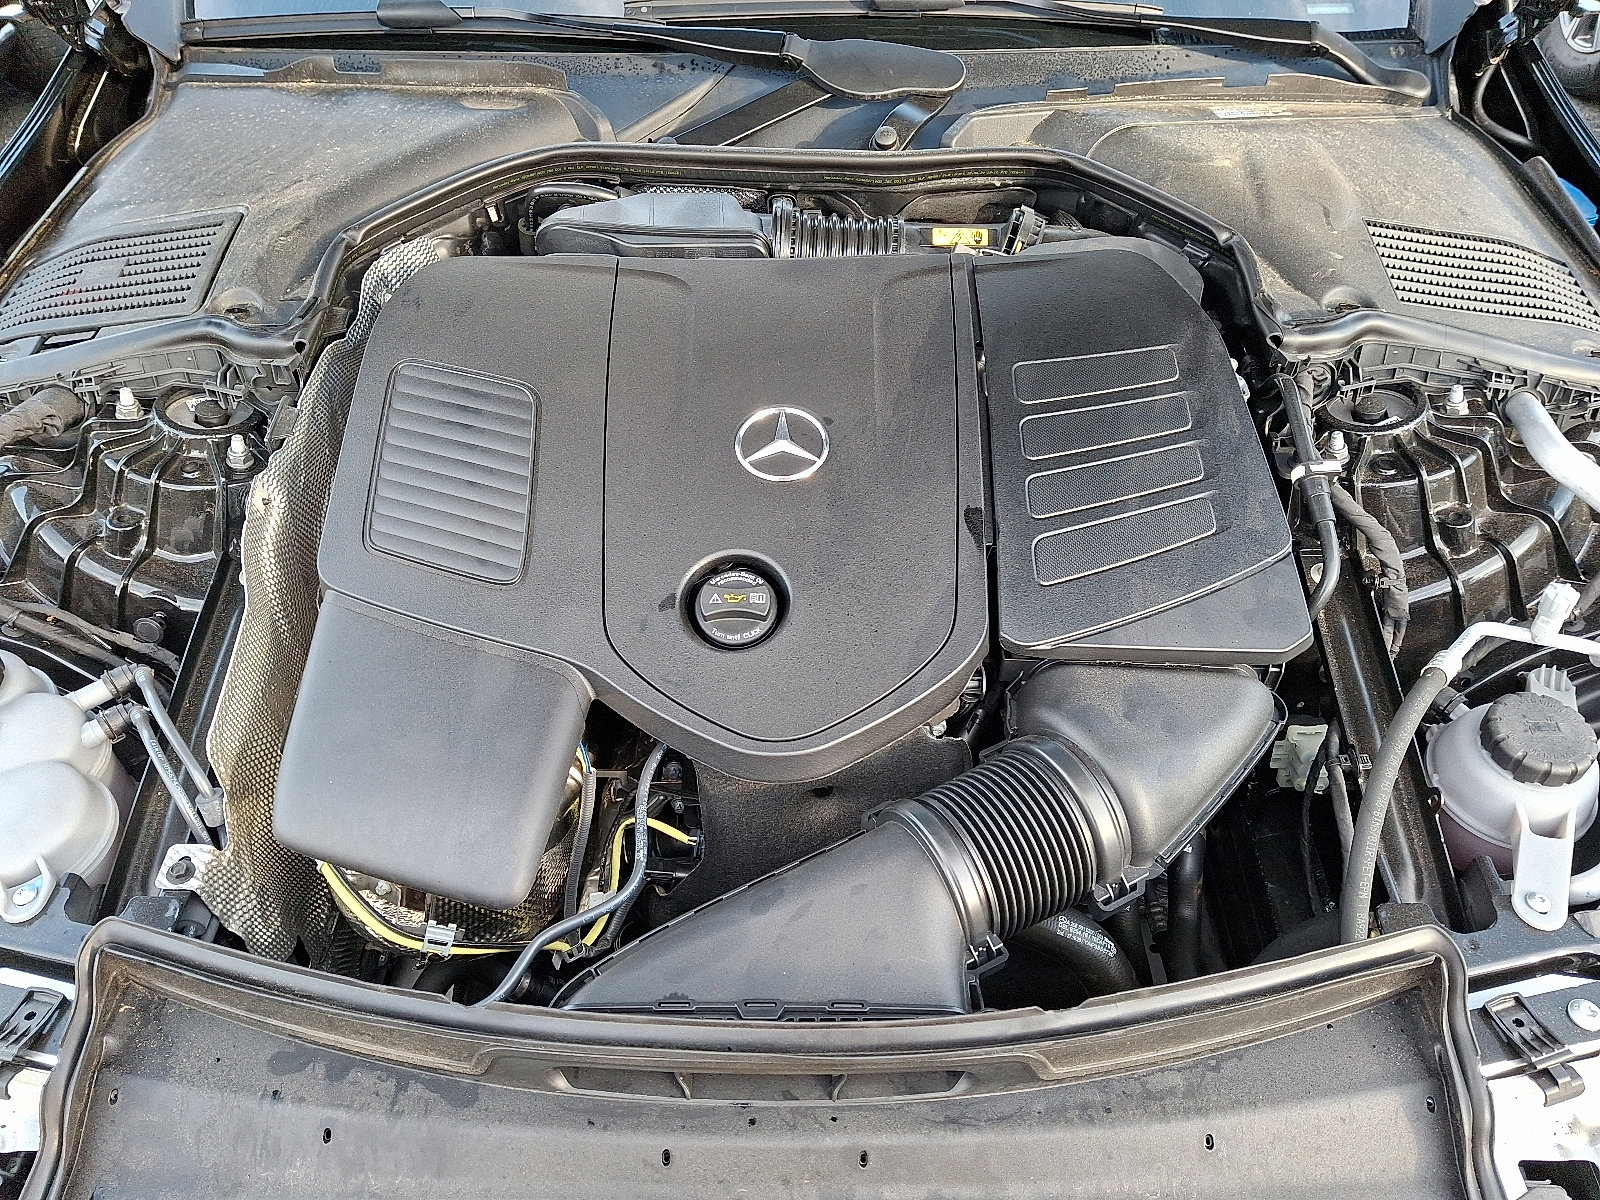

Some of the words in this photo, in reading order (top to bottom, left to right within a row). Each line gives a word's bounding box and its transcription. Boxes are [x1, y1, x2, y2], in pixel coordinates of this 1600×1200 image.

[717, 575, 757, 586] recommended
[711, 627, 725, 639] Turn
[726, 633, 741, 641] until
[743, 626, 762, 639] CLICK
